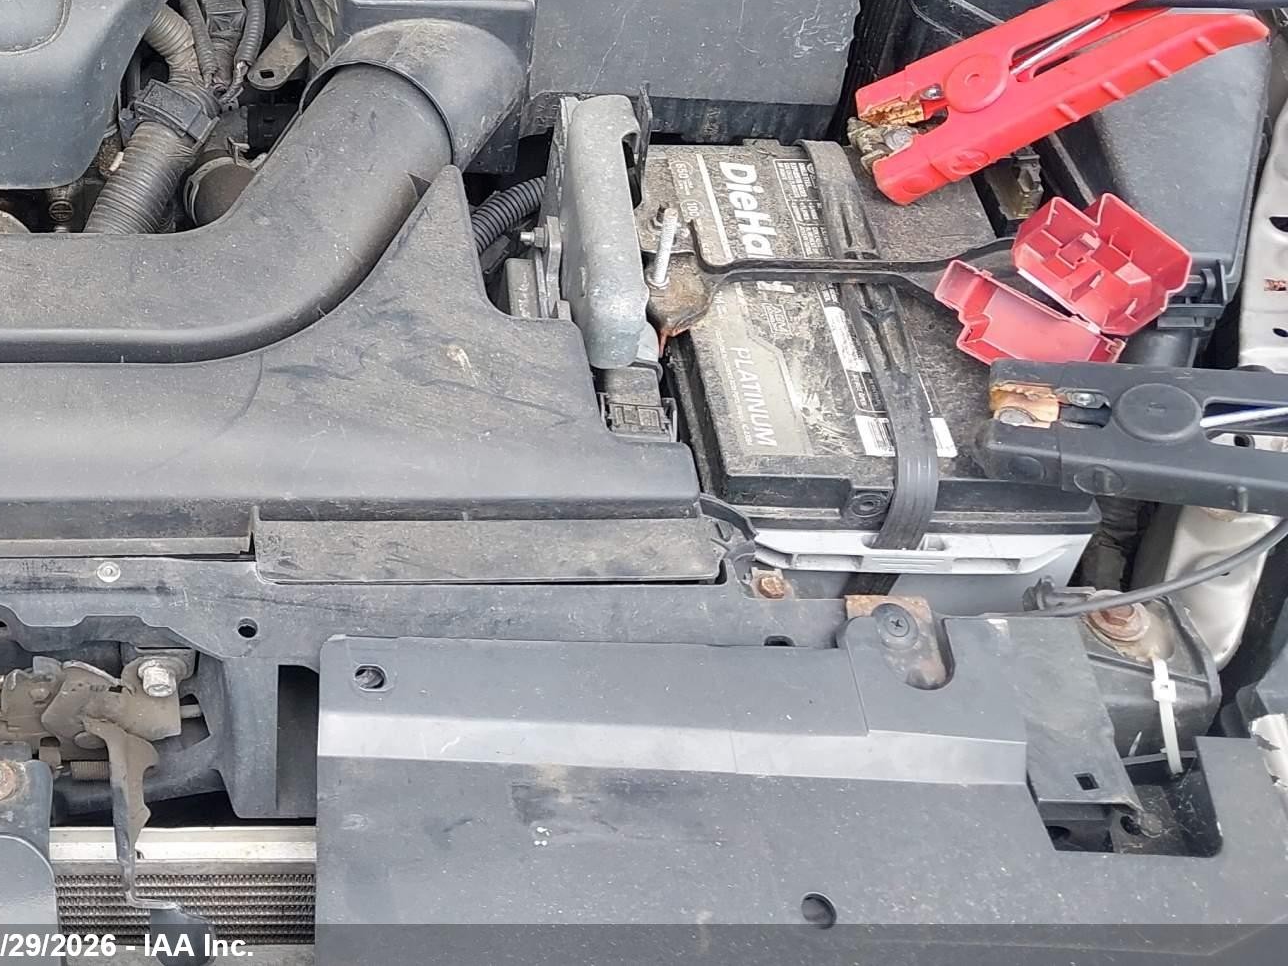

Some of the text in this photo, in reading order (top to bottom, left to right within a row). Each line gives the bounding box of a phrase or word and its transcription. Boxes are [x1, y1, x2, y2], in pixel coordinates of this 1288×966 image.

[686, 202, 701, 217] 100
[718, 161, 796, 294] DieHad
[728, 347, 778, 447] PLATINUM
